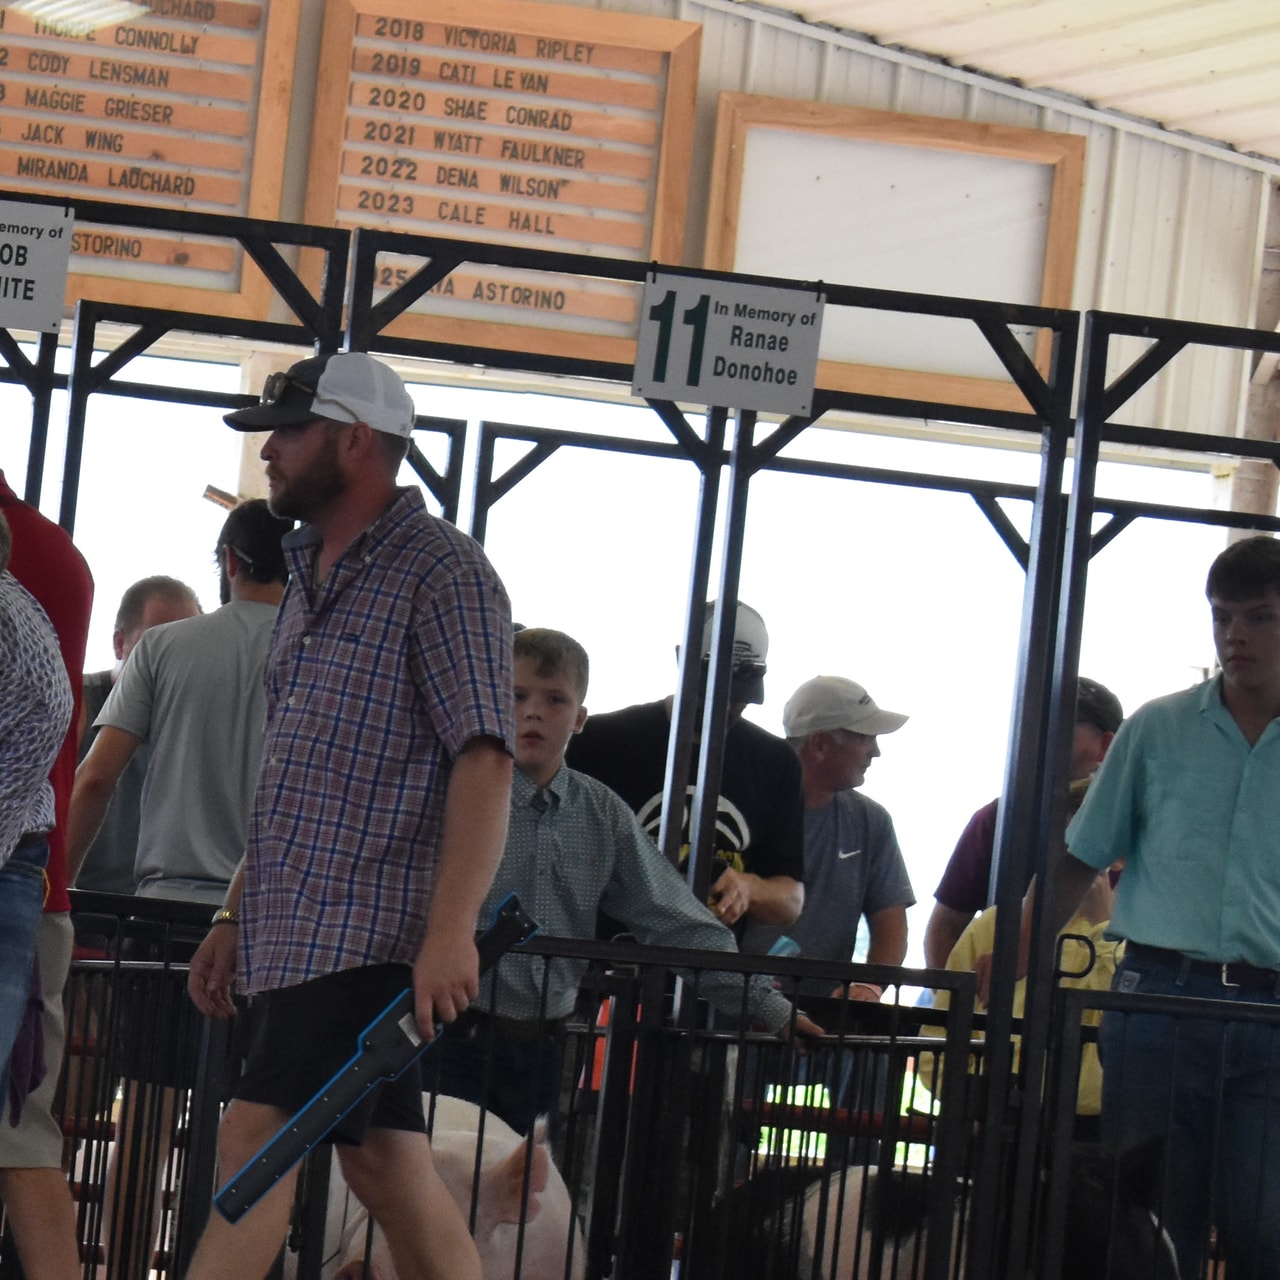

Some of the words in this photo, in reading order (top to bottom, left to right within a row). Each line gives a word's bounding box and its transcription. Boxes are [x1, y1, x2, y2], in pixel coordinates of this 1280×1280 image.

[114, 26, 200, 56] CONNOLLY
[374, 16, 425, 43] 2018
[443, 26, 518, 56] VICTORIA
[536, 37, 596, 64] RIPLEY
[26, 51, 71, 76] CODY
[88, 59, 170, 88] LENSMAN
[370, 51, 422, 78] 2019
[439, 61, 476, 86] CATI
[25, 87, 86, 115] MAGGIE
[104, 97, 174, 126] GRIESER
[368, 86, 426, 113] 2020
[443, 96, 488, 122] SHAE
[505, 105, 573, 133] CONRAD
[21, 122, 65, 147] JACK
[84, 129, 125, 154] WING
[363, 120, 415, 147] 2021
[433, 128, 484, 156] WYATT
[500, 139, 586, 169] FAULKNER
[16, 156, 89, 185] MIRANDA
[107, 166, 196, 197] LAUCHARD
[360, 155, 419, 182] 2022
[436, 164, 479, 190] DENA
[499, 174, 560, 200] WILSON
[357, 189, 415, 216] 2023
[438, 200, 486, 227] CALE
[508, 210, 556, 236] HALL
[47, 224, 64, 240] of
[70, 231, 143, 259] STORINO
[472, 280, 567, 312] ASTORINO
[648, 289, 712, 388] 11
[713, 300, 729, 316] In
[733, 303, 797, 328] Memory
[800, 312, 817, 327] of
[729, 324, 789, 352] Ranae
[712, 355, 798, 387] Donohoe
